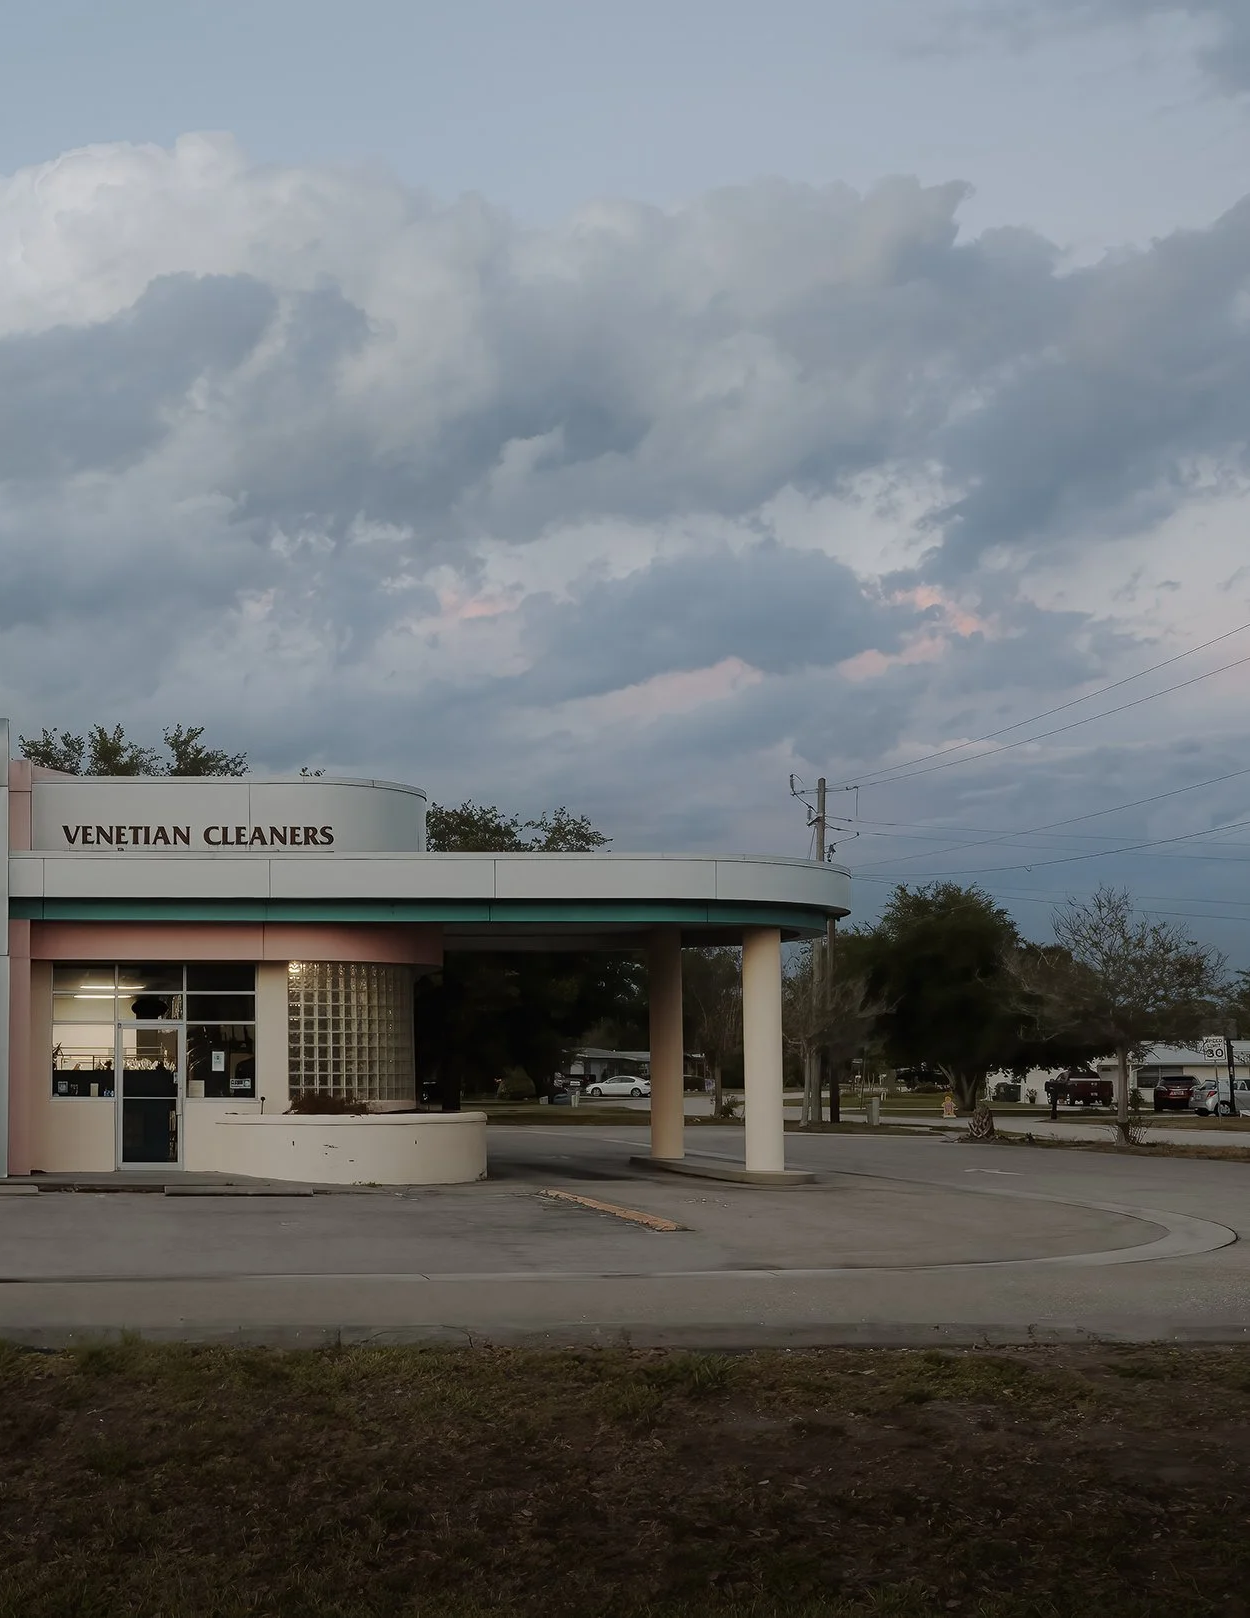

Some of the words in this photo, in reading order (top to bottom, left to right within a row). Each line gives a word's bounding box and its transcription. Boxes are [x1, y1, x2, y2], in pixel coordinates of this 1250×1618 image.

[62, 825, 190, 845] VENETIAN
[203, 826, 334, 846] CLEANERS
[1206, 1049, 1224, 1058] 30
